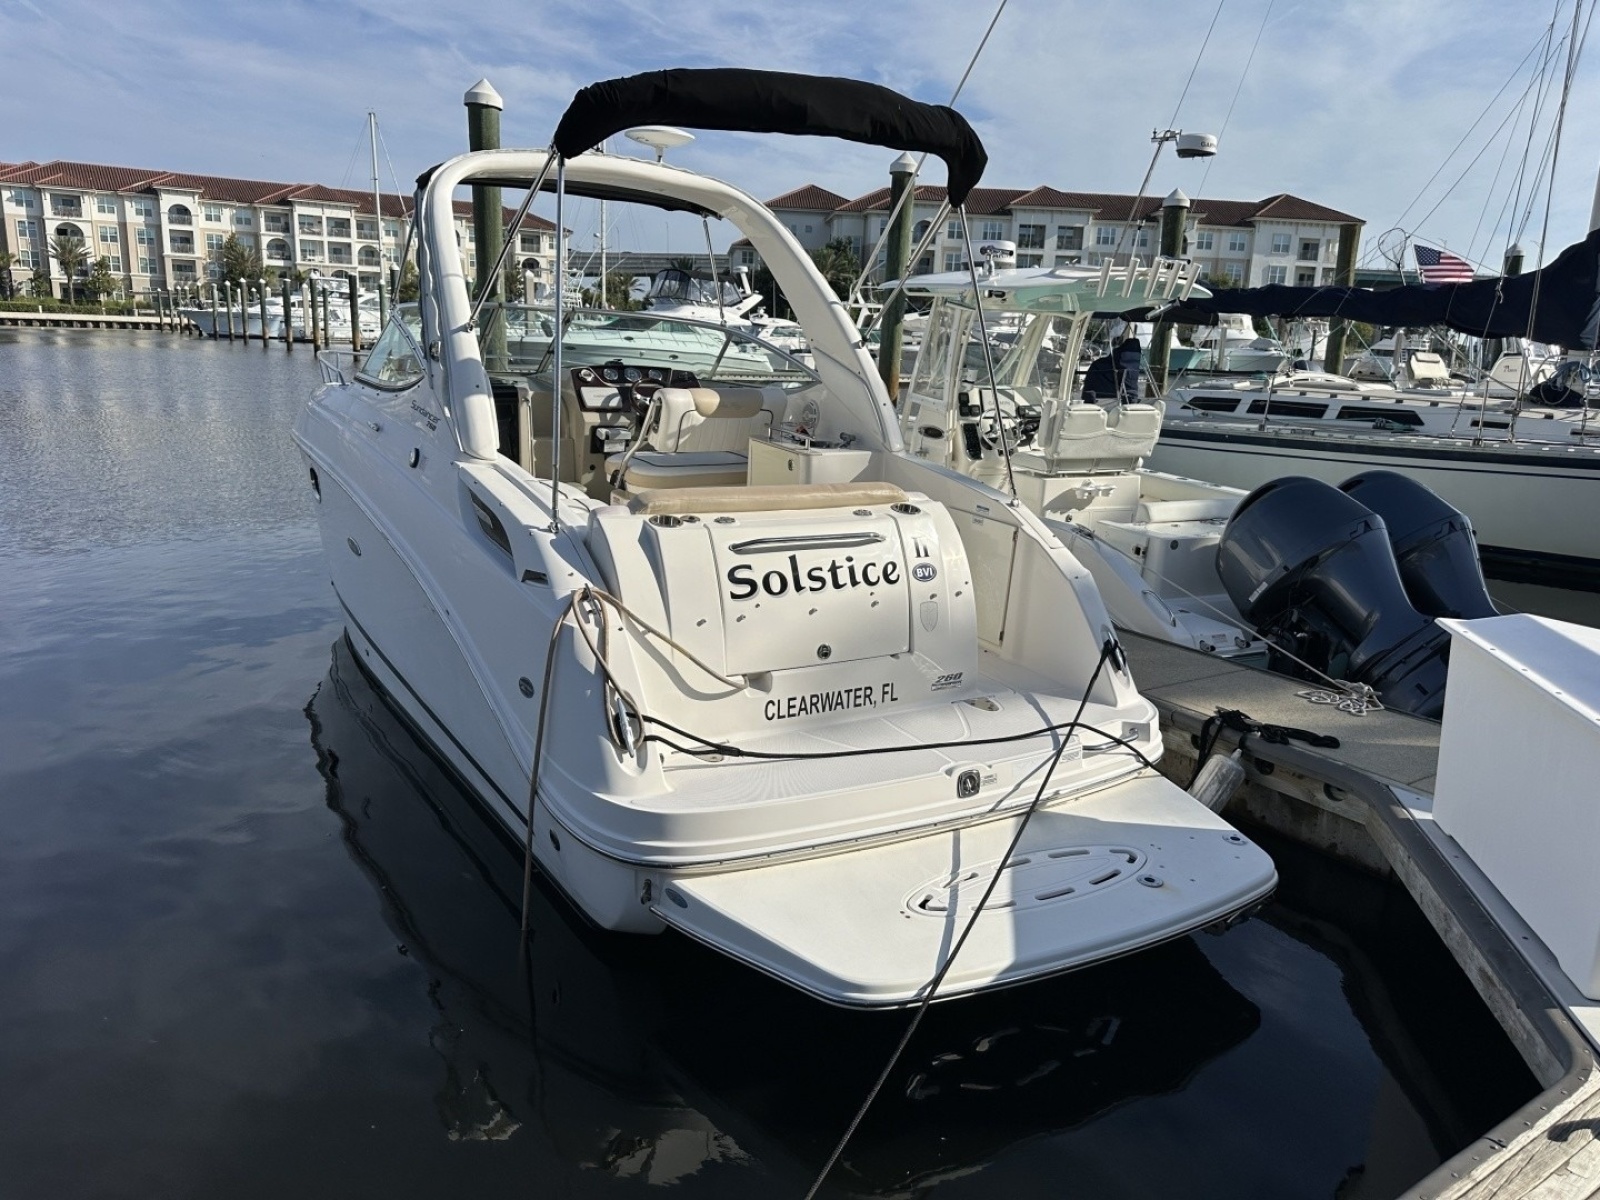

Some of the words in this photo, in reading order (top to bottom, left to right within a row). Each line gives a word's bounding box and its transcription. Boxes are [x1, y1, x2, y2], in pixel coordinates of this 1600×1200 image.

[727, 554, 900, 599] Solstice
[916, 568, 933, 578] BVI
[935, 672, 963, 683] 260
[764, 686, 877, 721] CLEARWATER,
[881, 682, 899, 703] FL
